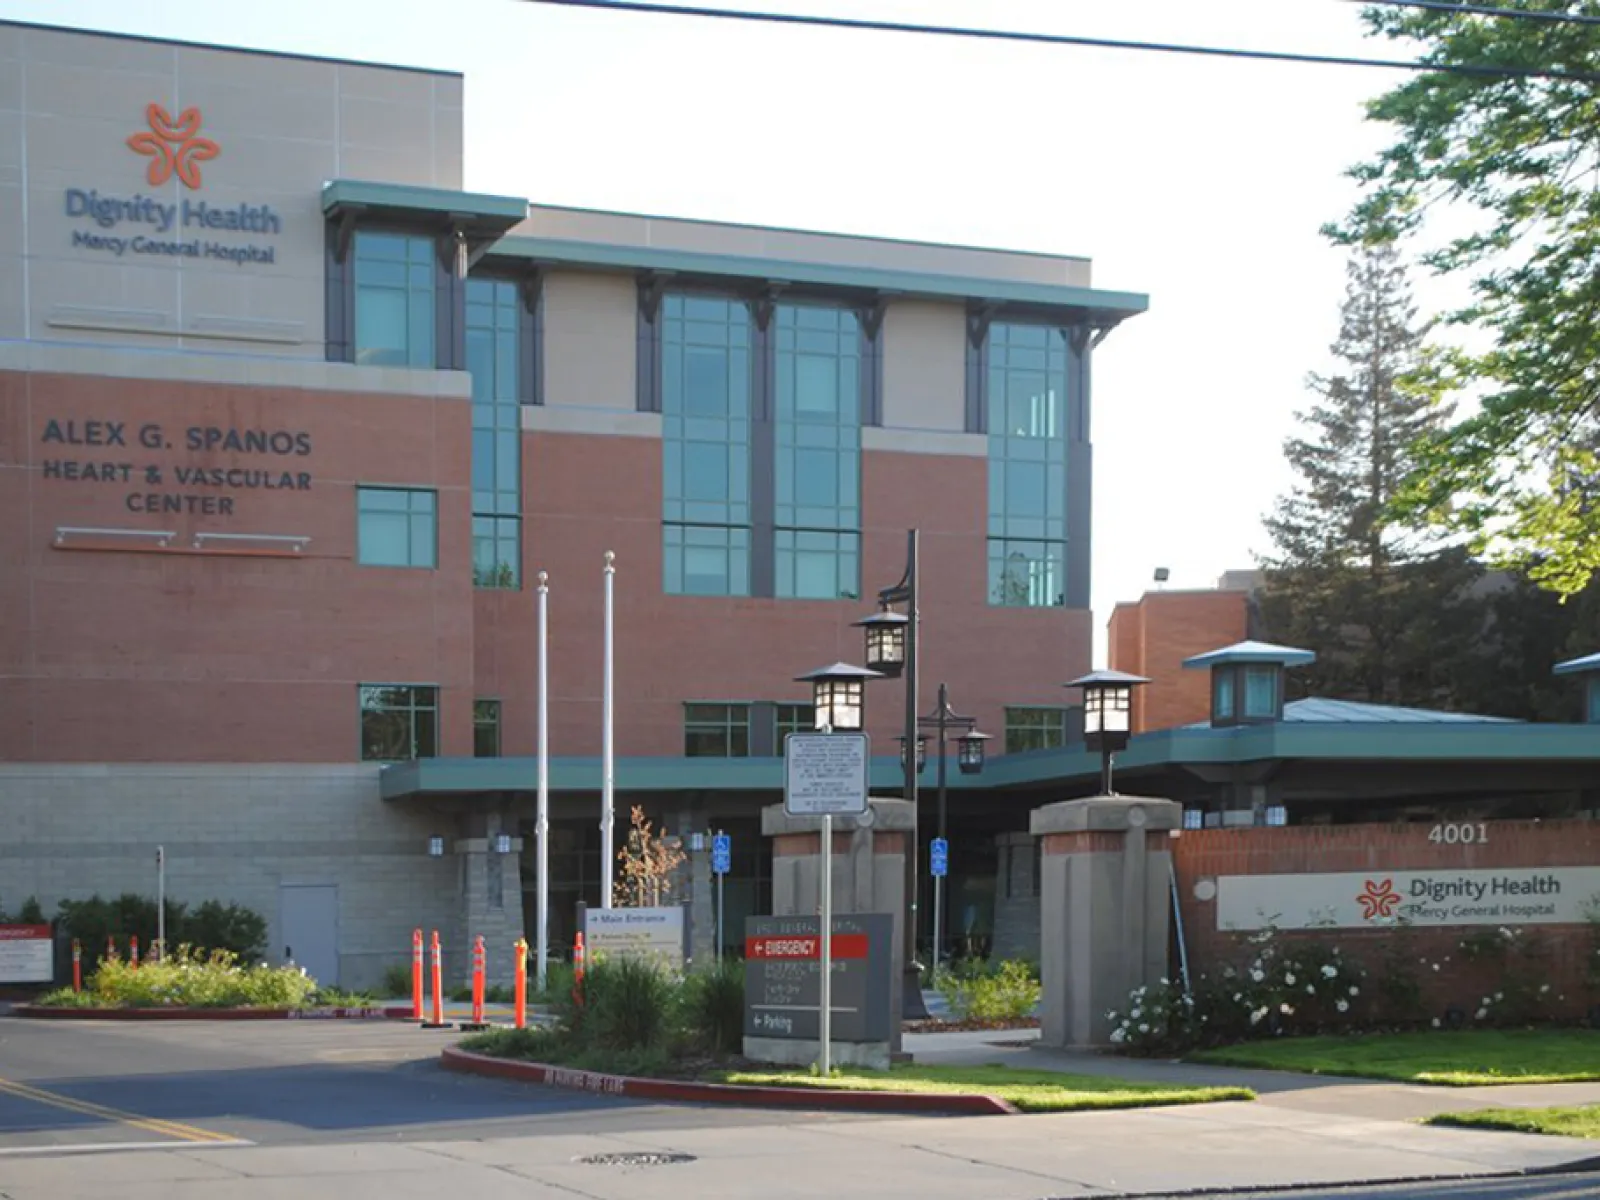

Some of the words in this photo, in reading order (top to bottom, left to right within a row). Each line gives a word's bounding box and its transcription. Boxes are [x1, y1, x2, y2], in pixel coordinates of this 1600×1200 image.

[65, 188, 176, 232] Dignity
[182, 200, 280, 234] Health
[72, 230, 128, 256] Mercy
[131, 236, 198, 257] General
[204, 242, 274, 265] Hospital
[42, 420, 126, 446] ALEX
[138, 424, 172, 450] G.
[186, 427, 311, 456] SPANOS
[43, 460, 132, 483] HEART
[145, 465, 162, 485] &
[174, 466, 311, 490] VASCULAR
[126, 493, 234, 515] CENTER
[1428, 823, 1488, 844] 4001
[1410, 877, 1487, 901] Dignity
[1491, 875, 1561, 895] Health
[601, 914, 622, 923] Main
[625, 914, 666, 923] Entrance
[1452, 903, 1499, 917] General
[1502, 903, 1555, 918] Hospital
[765, 939, 816, 956] EMERGENCY
[763, 1013, 793, 1034] Parking
